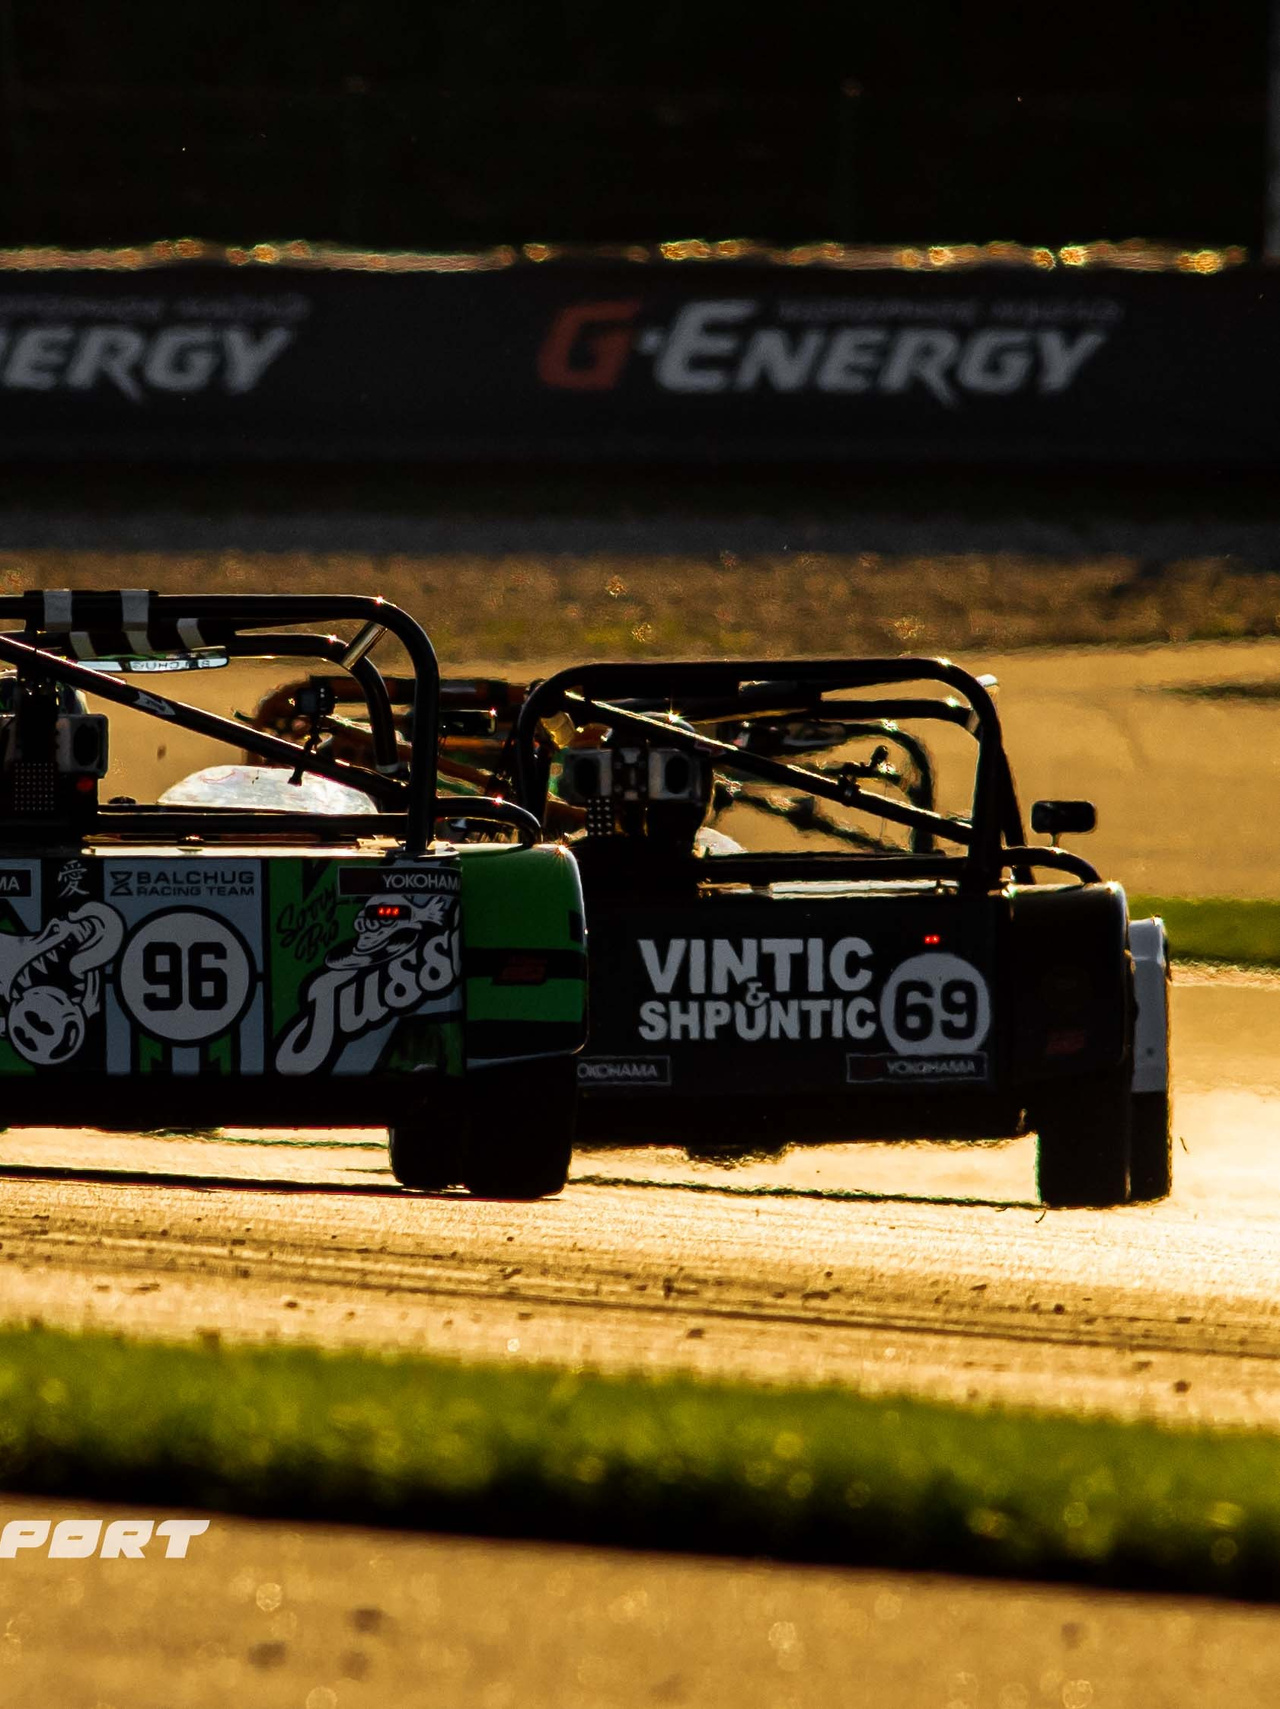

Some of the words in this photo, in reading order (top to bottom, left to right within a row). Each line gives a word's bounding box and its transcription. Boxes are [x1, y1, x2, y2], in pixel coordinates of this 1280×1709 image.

[57, 859, 91, 900] 愛
[137, 870, 255, 885] BALCHUG
[382, 873, 461, 889] YOKOHAM
[137, 886, 201, 897] RACING
[208, 886, 255, 897] TEAM
[143, 942, 228, 1011] 96
[637, 936, 875, 996] VINTIC
[745, 981, 771, 1008] &
[638, 996, 877, 1042] SHPUNTIC
[894, 980, 979, 1042] 69
[576, 1062, 658, 1079] OKOHAMA
[886, 1059, 976, 1075] YOKOHAMA
